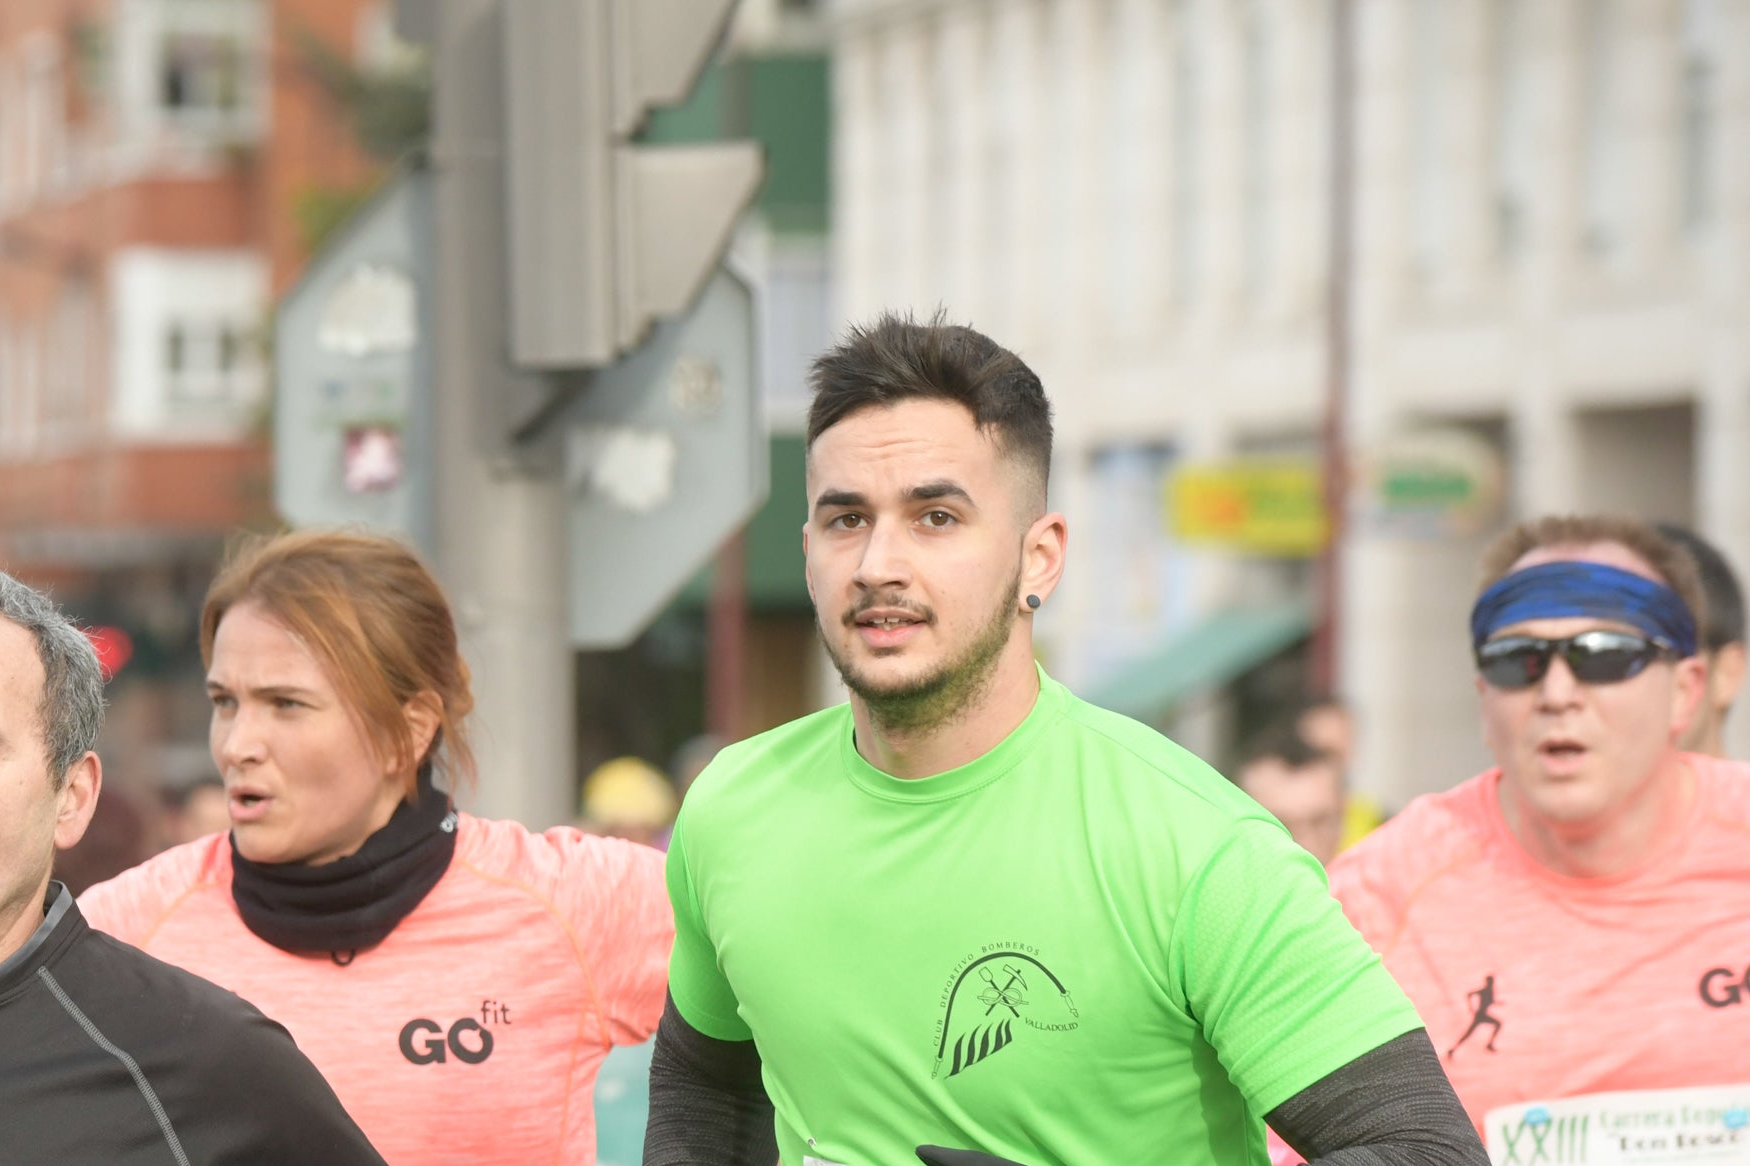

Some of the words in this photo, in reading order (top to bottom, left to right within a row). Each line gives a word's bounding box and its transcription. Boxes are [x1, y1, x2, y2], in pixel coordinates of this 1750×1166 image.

[932, 1018, 944, 1047] CLUB
[939, 952, 975, 1009] DEPORTIVO
[980, 940, 1041, 957] BOMBEROS
[1698, 967, 1750, 1009] G
[398, 1017, 494, 1066] GO
[481, 999, 512, 1025] fit
[1024, 1016, 1080, 1032] VALLADOLID
